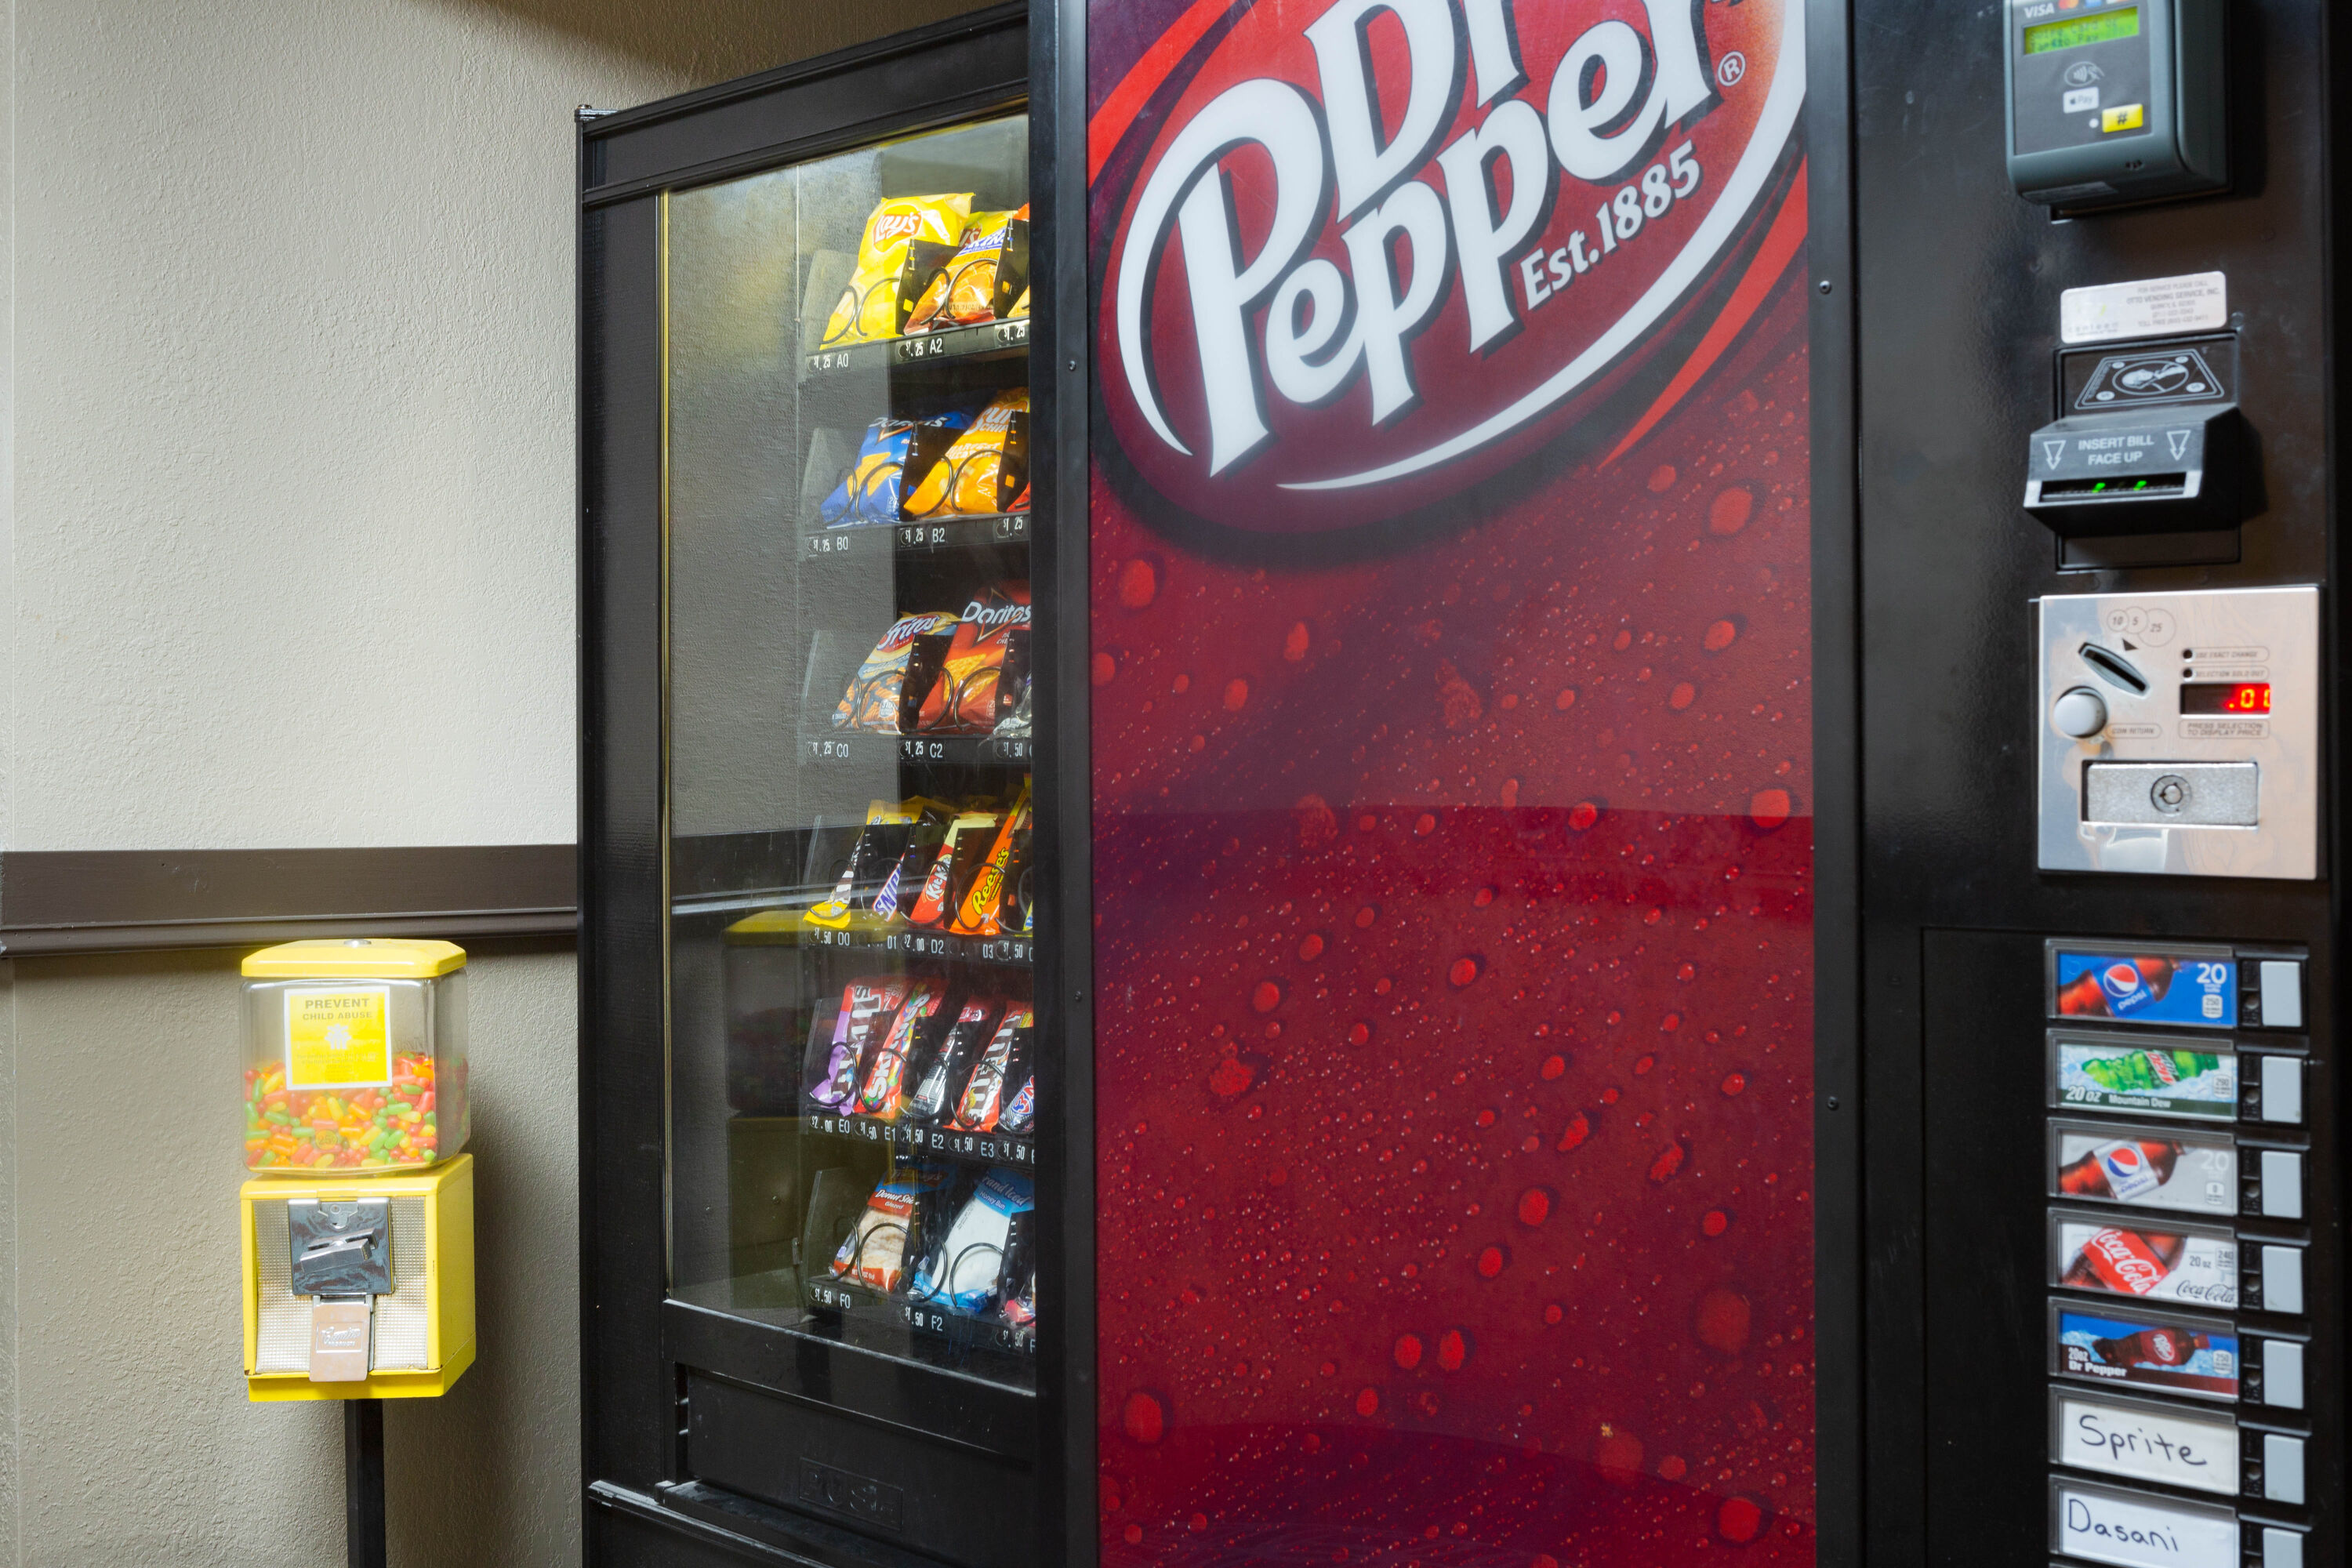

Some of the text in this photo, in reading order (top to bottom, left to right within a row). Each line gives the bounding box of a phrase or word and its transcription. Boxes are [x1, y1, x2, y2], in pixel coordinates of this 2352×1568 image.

[2024, 2, 2055, 19] VISA
[874, 213, 921, 245] Lay's
[1118, 0, 1712, 477] Pepper
[2145, 293, 2174, 303] VENDING
[930, 338, 943, 354] A2
[2078, 435, 2154, 451] INSERT BILL
[2089, 451, 2143, 465] FACE UP
[932, 528, 946, 543] B2
[962, 601, 1031, 624] Doritos
[2112, 615, 2123, 626] 10
[2132, 615, 2139, 626] 5
[2150, 623, 2164, 633] 25
[877, 615, 940, 651] Fritos
[930, 744, 943, 758] C2
[931, 939, 944, 954] D2
[2197, 964, 2227, 985] 20
[305, 998, 369, 1010] PREVENT
[2118, 989, 2147, 1011] pepsi
[303, 1011, 372, 1021] CHILD ABUSE
[2066, 1086, 2101, 1102] 20 oz
[2109, 1094, 2171, 1109] Mountain Dew
[884, 1127, 896, 1141] E1
[931, 1136, 944, 1149] E2
[981, 1142, 994, 1157] E3
[2201, 1151, 2229, 1171] 20
[875, 1189, 902, 1202] Donut
[979, 1190, 1006, 1210] Honey Bun
[2190, 1255, 2201, 1267] 20
[931, 1316, 943, 1331] F2
[2068, 1359, 2127, 1377] Dr Pepper
[2079, 1414, 2208, 1466] Sprite
[2068, 1498, 2179, 1552] Dasani
